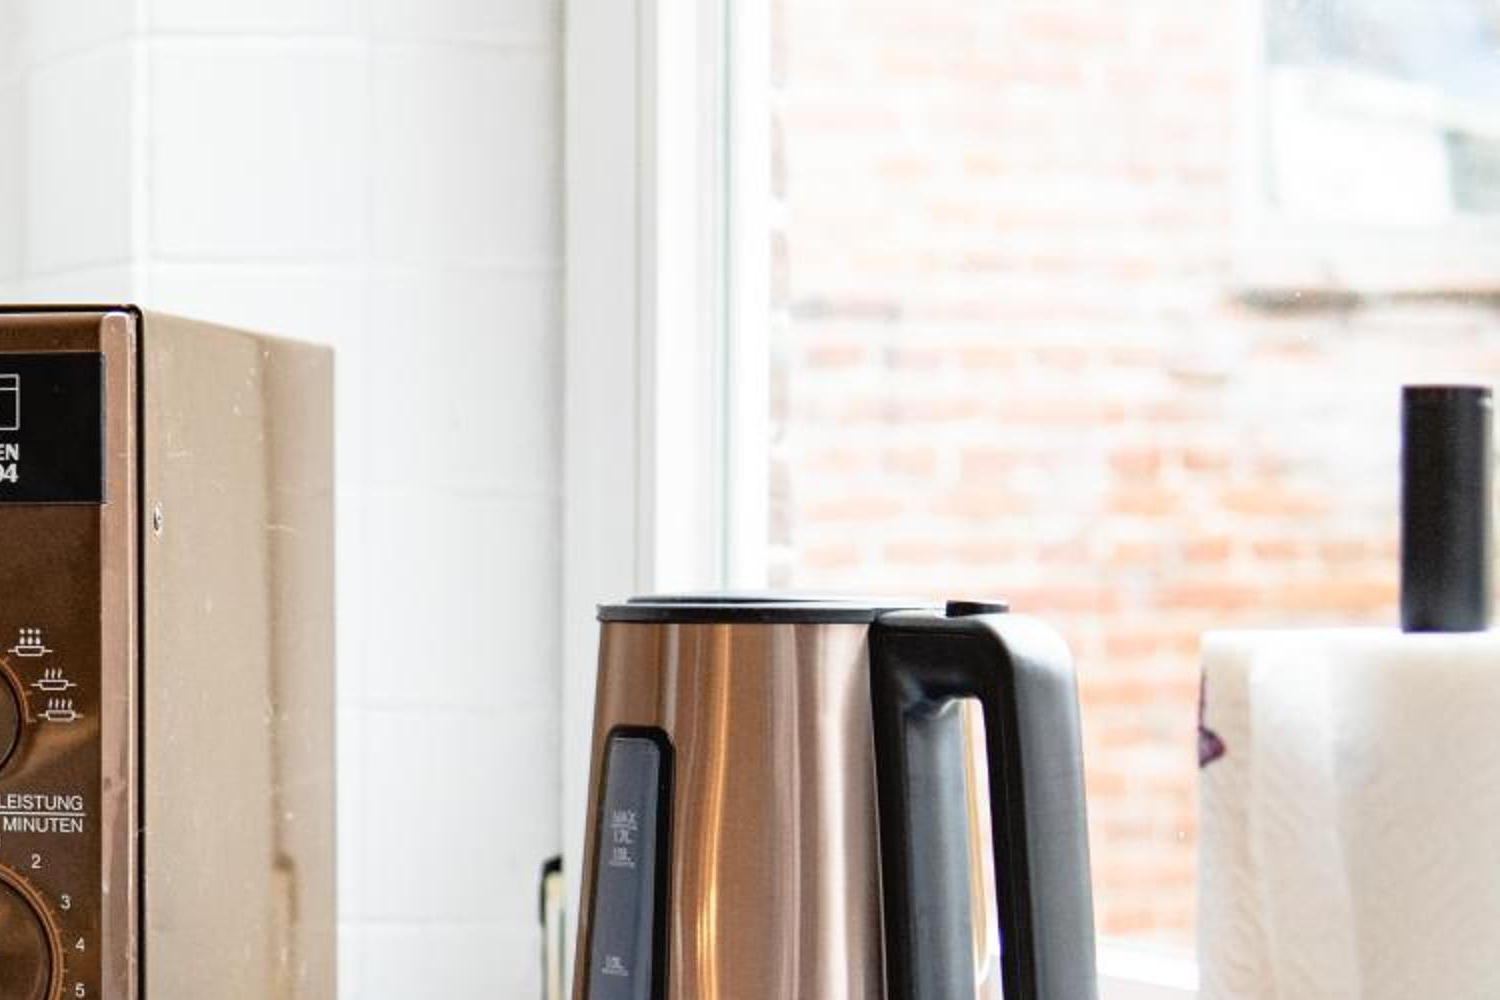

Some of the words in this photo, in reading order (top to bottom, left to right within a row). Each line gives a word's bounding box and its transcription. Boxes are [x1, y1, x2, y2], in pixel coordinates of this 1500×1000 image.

[3, 817, 83, 833] MINUTEN
[31, 855, 41, 869] 2
[60, 895, 71, 909] 3
[75, 938, 85, 952] 4
[75, 984, 85, 998] 5
